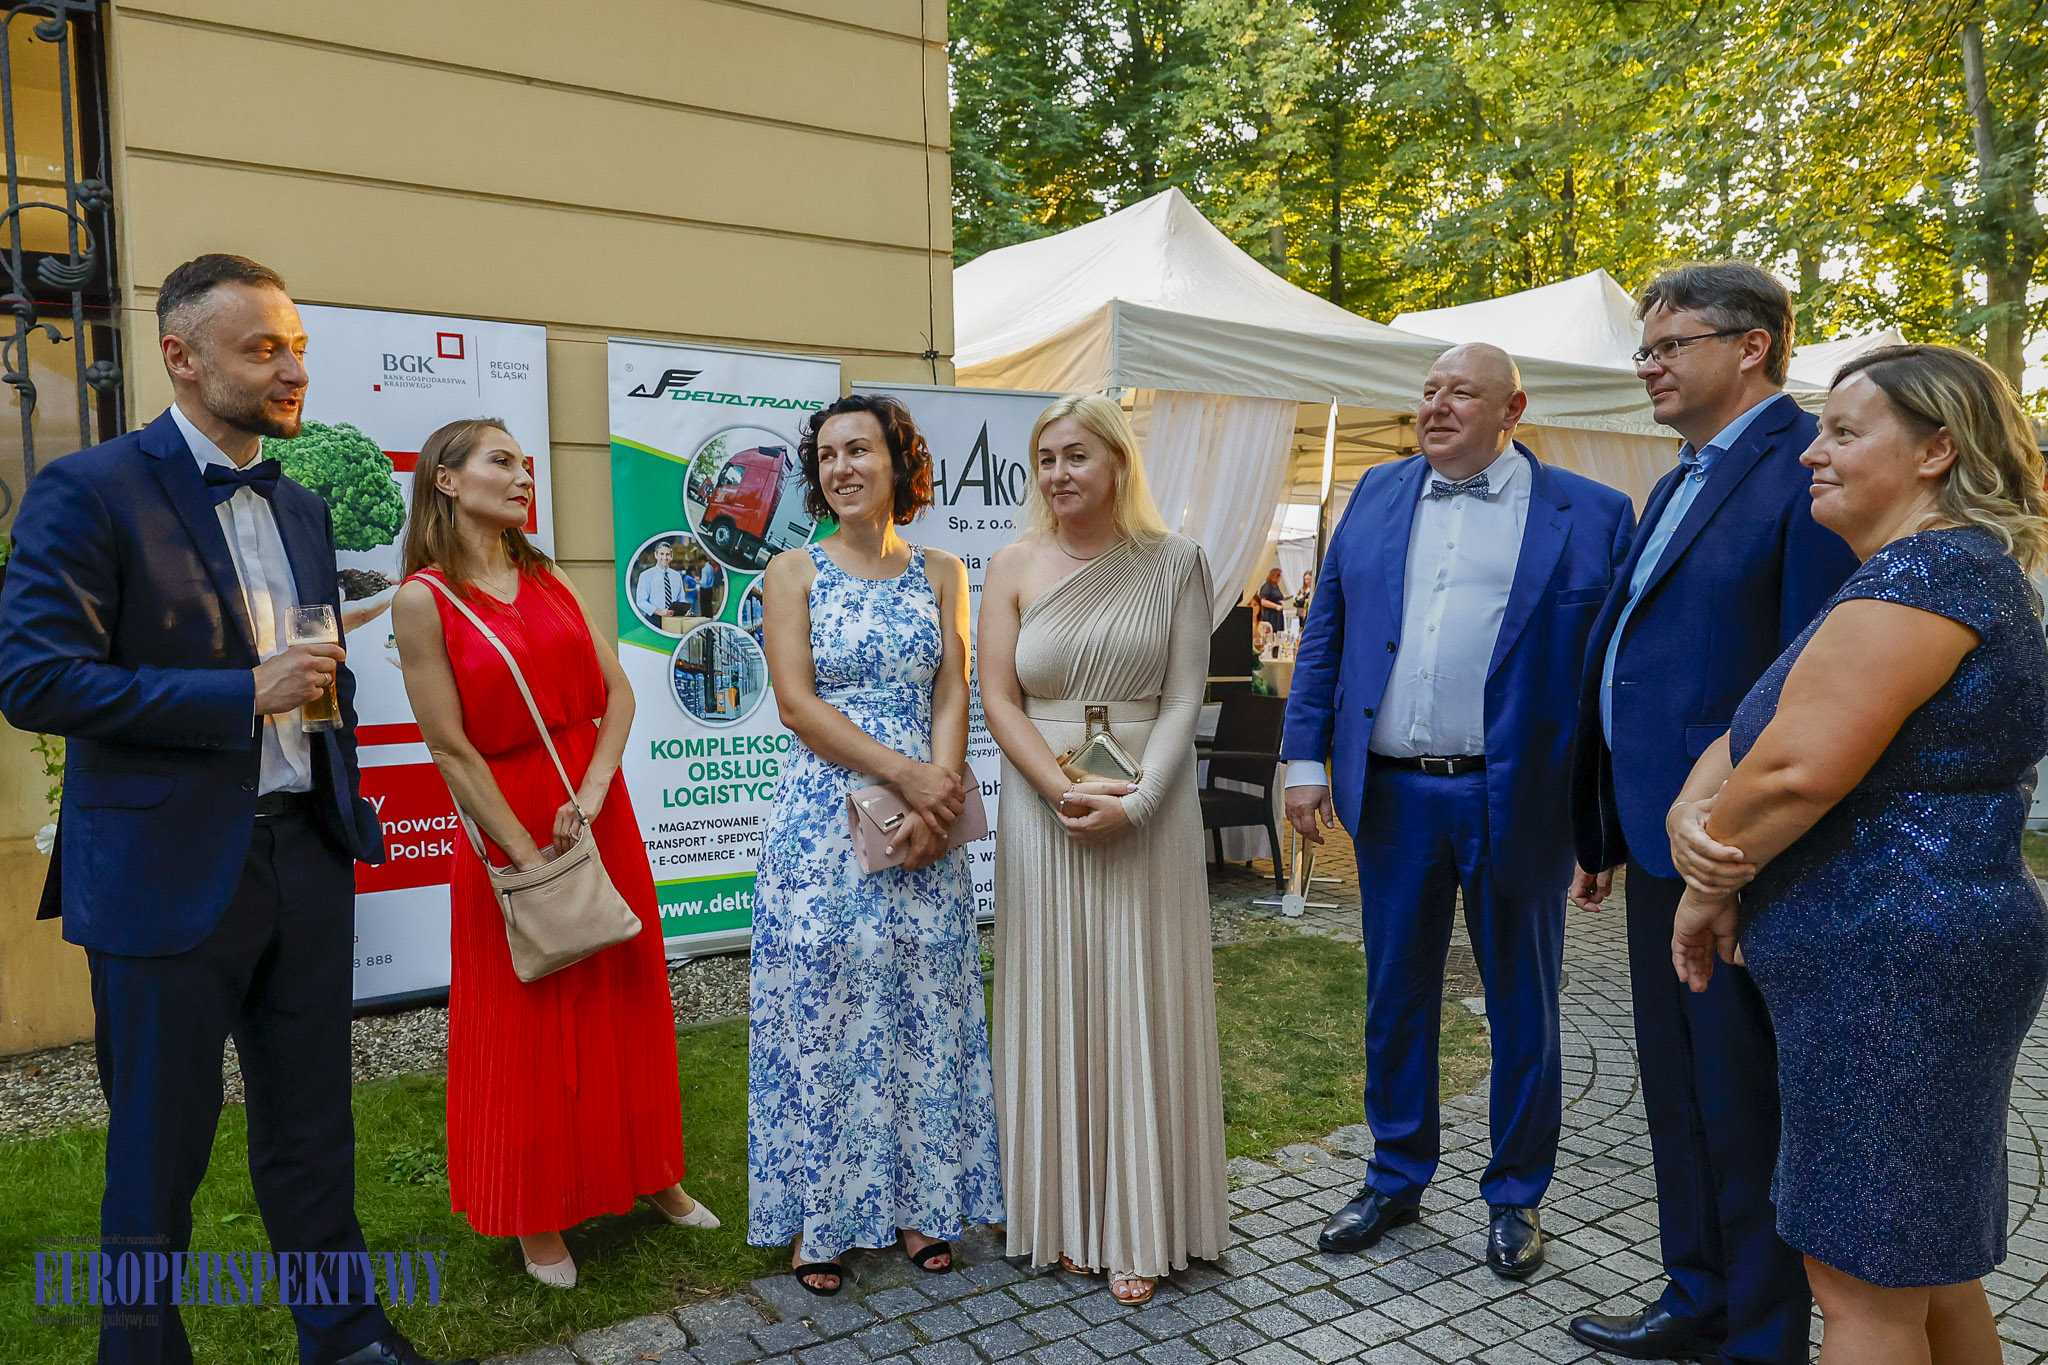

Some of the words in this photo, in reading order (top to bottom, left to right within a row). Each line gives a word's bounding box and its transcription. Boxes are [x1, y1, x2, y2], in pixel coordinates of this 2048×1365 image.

[383, 353, 434, 374] BGK
[490, 361, 529, 371] REGION
[384, 374, 403, 382] BANK
[406, 376, 466, 385] GOSPODARSTWA
[490, 369, 527, 380] ŚLĄSKI
[384, 381, 432, 389] KRAJOWEGO
[668, 388, 825, 411] DELTATRANS
[948, 516, 973, 533] Sp.
[977, 519, 985, 529] z
[990, 519, 1016, 530] o.o.
[650, 734, 791, 760] KOMPLEKSO
[688, 758, 779, 782] OBSŁUG
[663, 782, 774, 808] LOGISTYC
[381, 812, 458, 836] noważ
[658, 816, 759, 833] MAGAZYNOWANIE
[390, 838, 456, 861] Polsk
[644, 836, 707, 850] TRANSPORT
[659, 850, 735, 866] E-COMMERCE
[366, 954, 393, 966] 888
